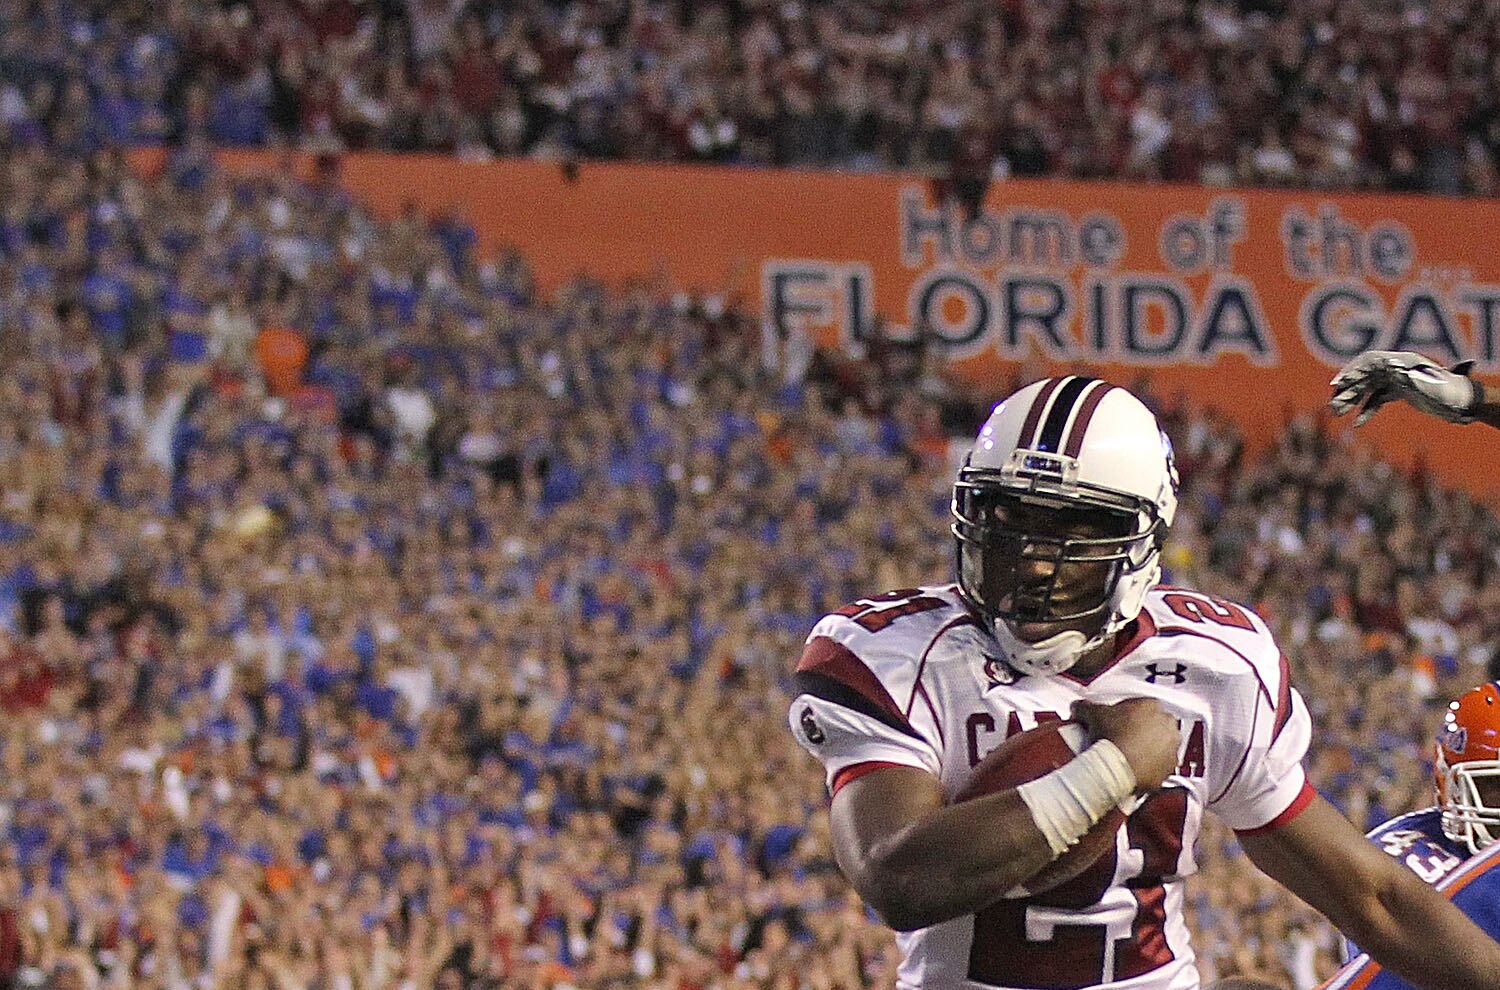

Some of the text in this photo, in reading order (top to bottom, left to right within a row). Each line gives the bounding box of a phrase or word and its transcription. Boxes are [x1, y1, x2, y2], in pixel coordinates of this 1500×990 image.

[902, 187, 1127, 268] Home
[1157, 197, 1244, 274] of
[763, 258, 1280, 366] FLORIDA
